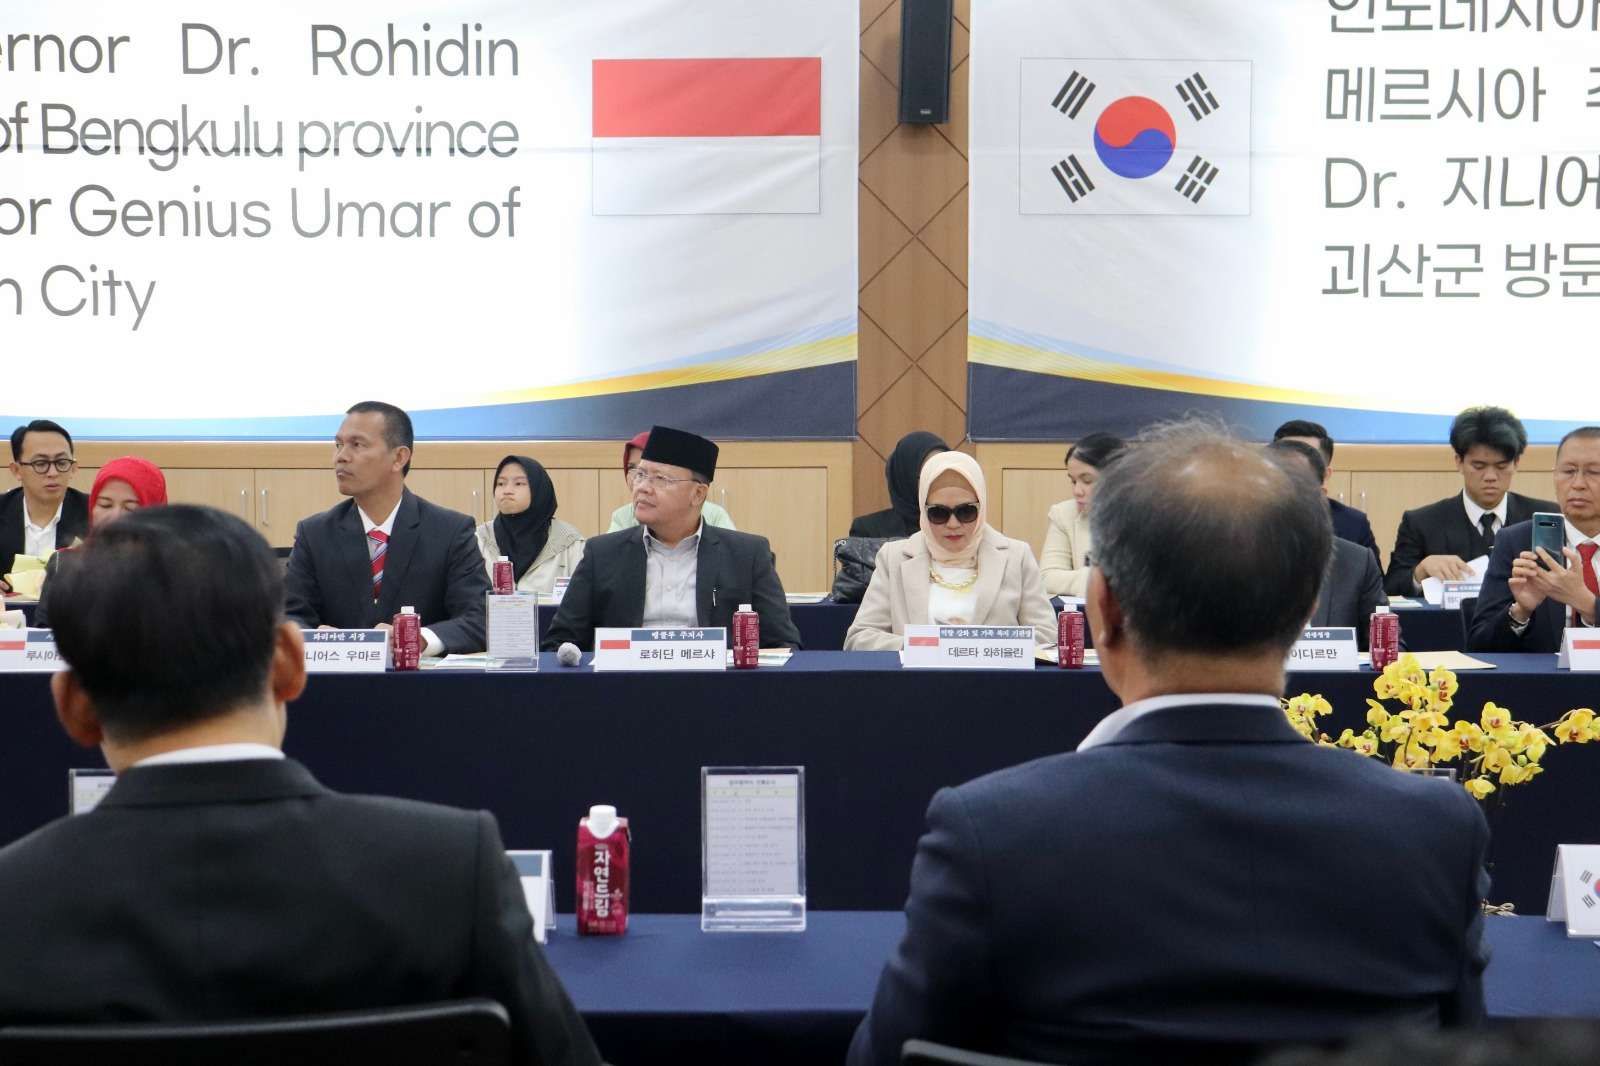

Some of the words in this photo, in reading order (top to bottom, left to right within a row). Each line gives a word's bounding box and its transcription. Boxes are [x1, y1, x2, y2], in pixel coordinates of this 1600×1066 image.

[0, 34, 130, 73] rnor
[182, 23, 259, 75] Dr.
[312, 23, 518, 76] Rohidin
[1326, 66, 1546, 122] 메르시아
[41, 103, 283, 171] Bengkulu
[299, 105, 519, 171] province
[1325, 158, 1405, 209] Dr.
[70, 184, 271, 237] Genius
[291, 188, 451, 238] Umar
[469, 186, 521, 238] of
[41, 264, 156, 331] City
[1322, 244, 1483, 298] 괴산군
[1505, 243, 1600, 298] 방문
[346, 650, 381, 661] 우마르
[948, 647, 979, 658] 데르타
